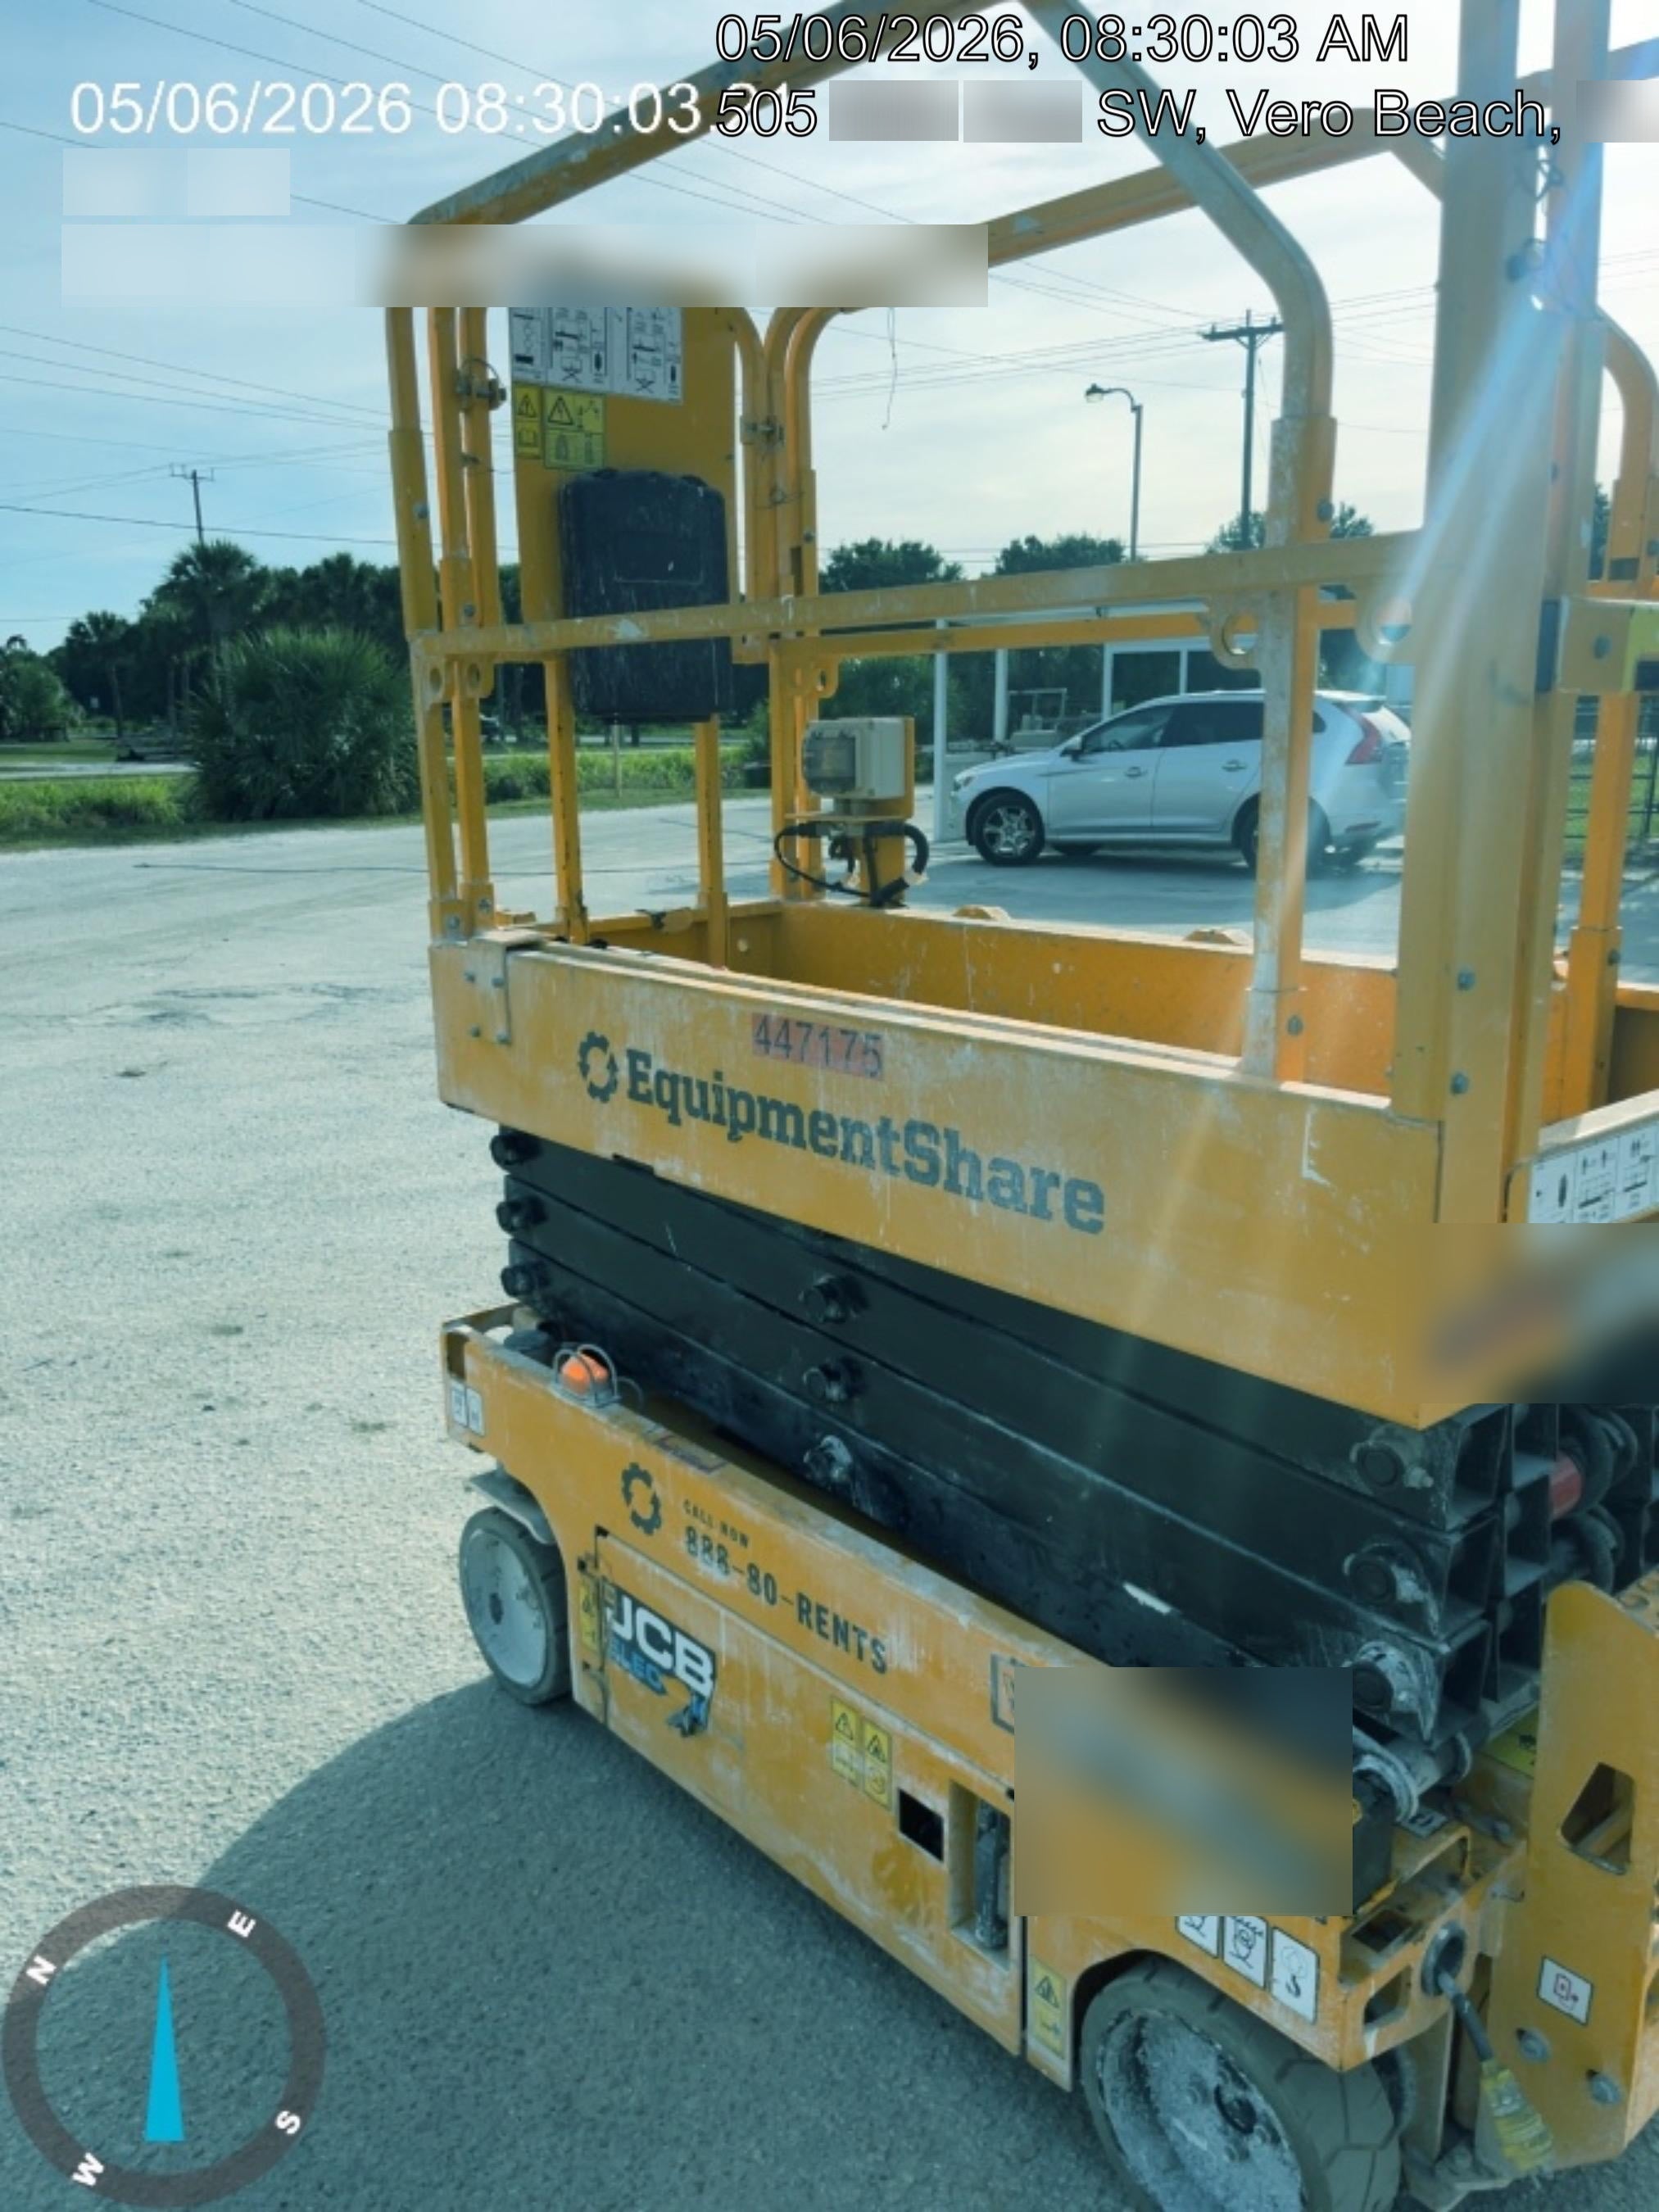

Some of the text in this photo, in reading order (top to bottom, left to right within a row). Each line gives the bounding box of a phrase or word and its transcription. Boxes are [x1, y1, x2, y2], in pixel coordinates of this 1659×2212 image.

[753, 1014, 884, 1078] 447175
[626, 1048, 1105, 1235] EquipmentShare
[605, 1593, 714, 1699] JCB
[685, 1525, 887, 1675] 888-80-RENTS
